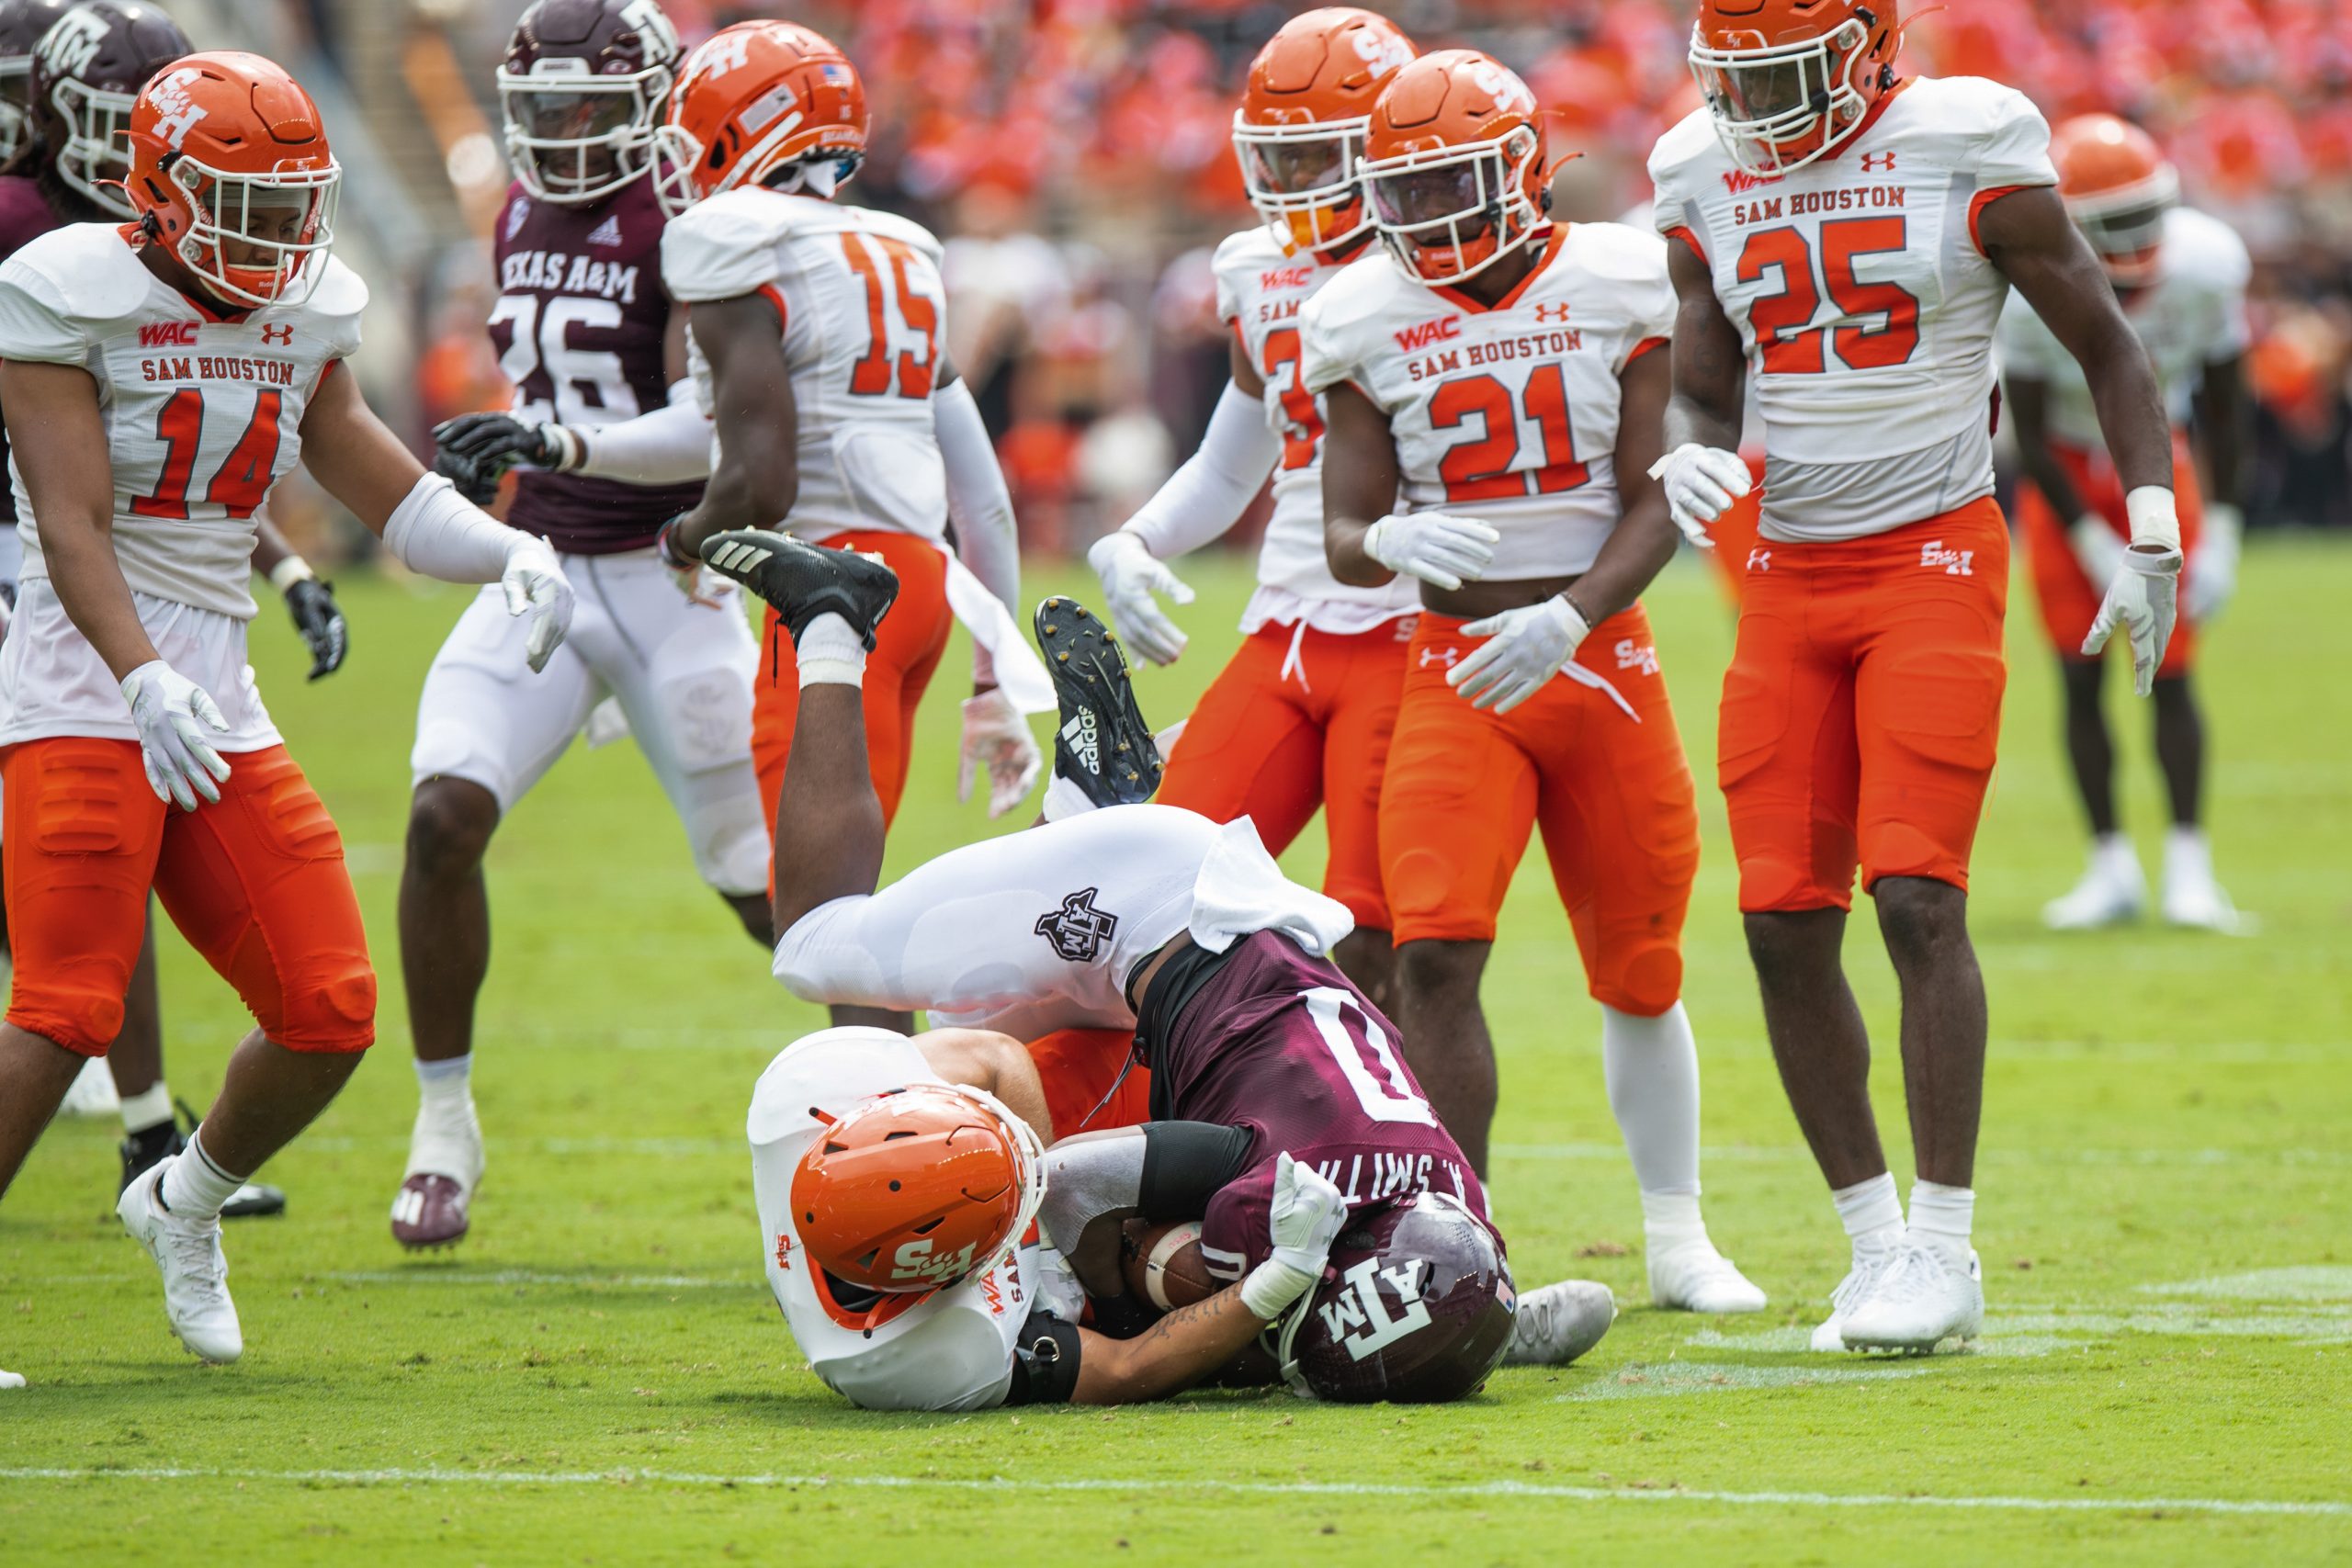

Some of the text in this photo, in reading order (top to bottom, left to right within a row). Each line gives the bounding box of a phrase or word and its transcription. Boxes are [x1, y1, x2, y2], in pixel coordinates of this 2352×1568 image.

[1735, 186, 1906, 225] SAM HOUSTON
[562, 254, 639, 304] A&M
[1261, 266, 1315, 292] WAC
[1736, 215, 1920, 374] 25
[139, 321, 200, 347] WAC
[840, 231, 937, 399] 15
[1260, 299, 1301, 322] SAM
[1394, 315, 1462, 353] WAC
[141, 356, 296, 387] SAM HOUSTON
[487, 293, 641, 432] 26
[1408, 329, 1583, 382] SAM HOUSTON
[128, 387, 283, 520] 14
[1427, 362, 1592, 502] 21
[1078, 705, 1101, 775] adidas
[1296, 986, 1438, 1129] 0
[979, 1268, 1005, 1318] WA
